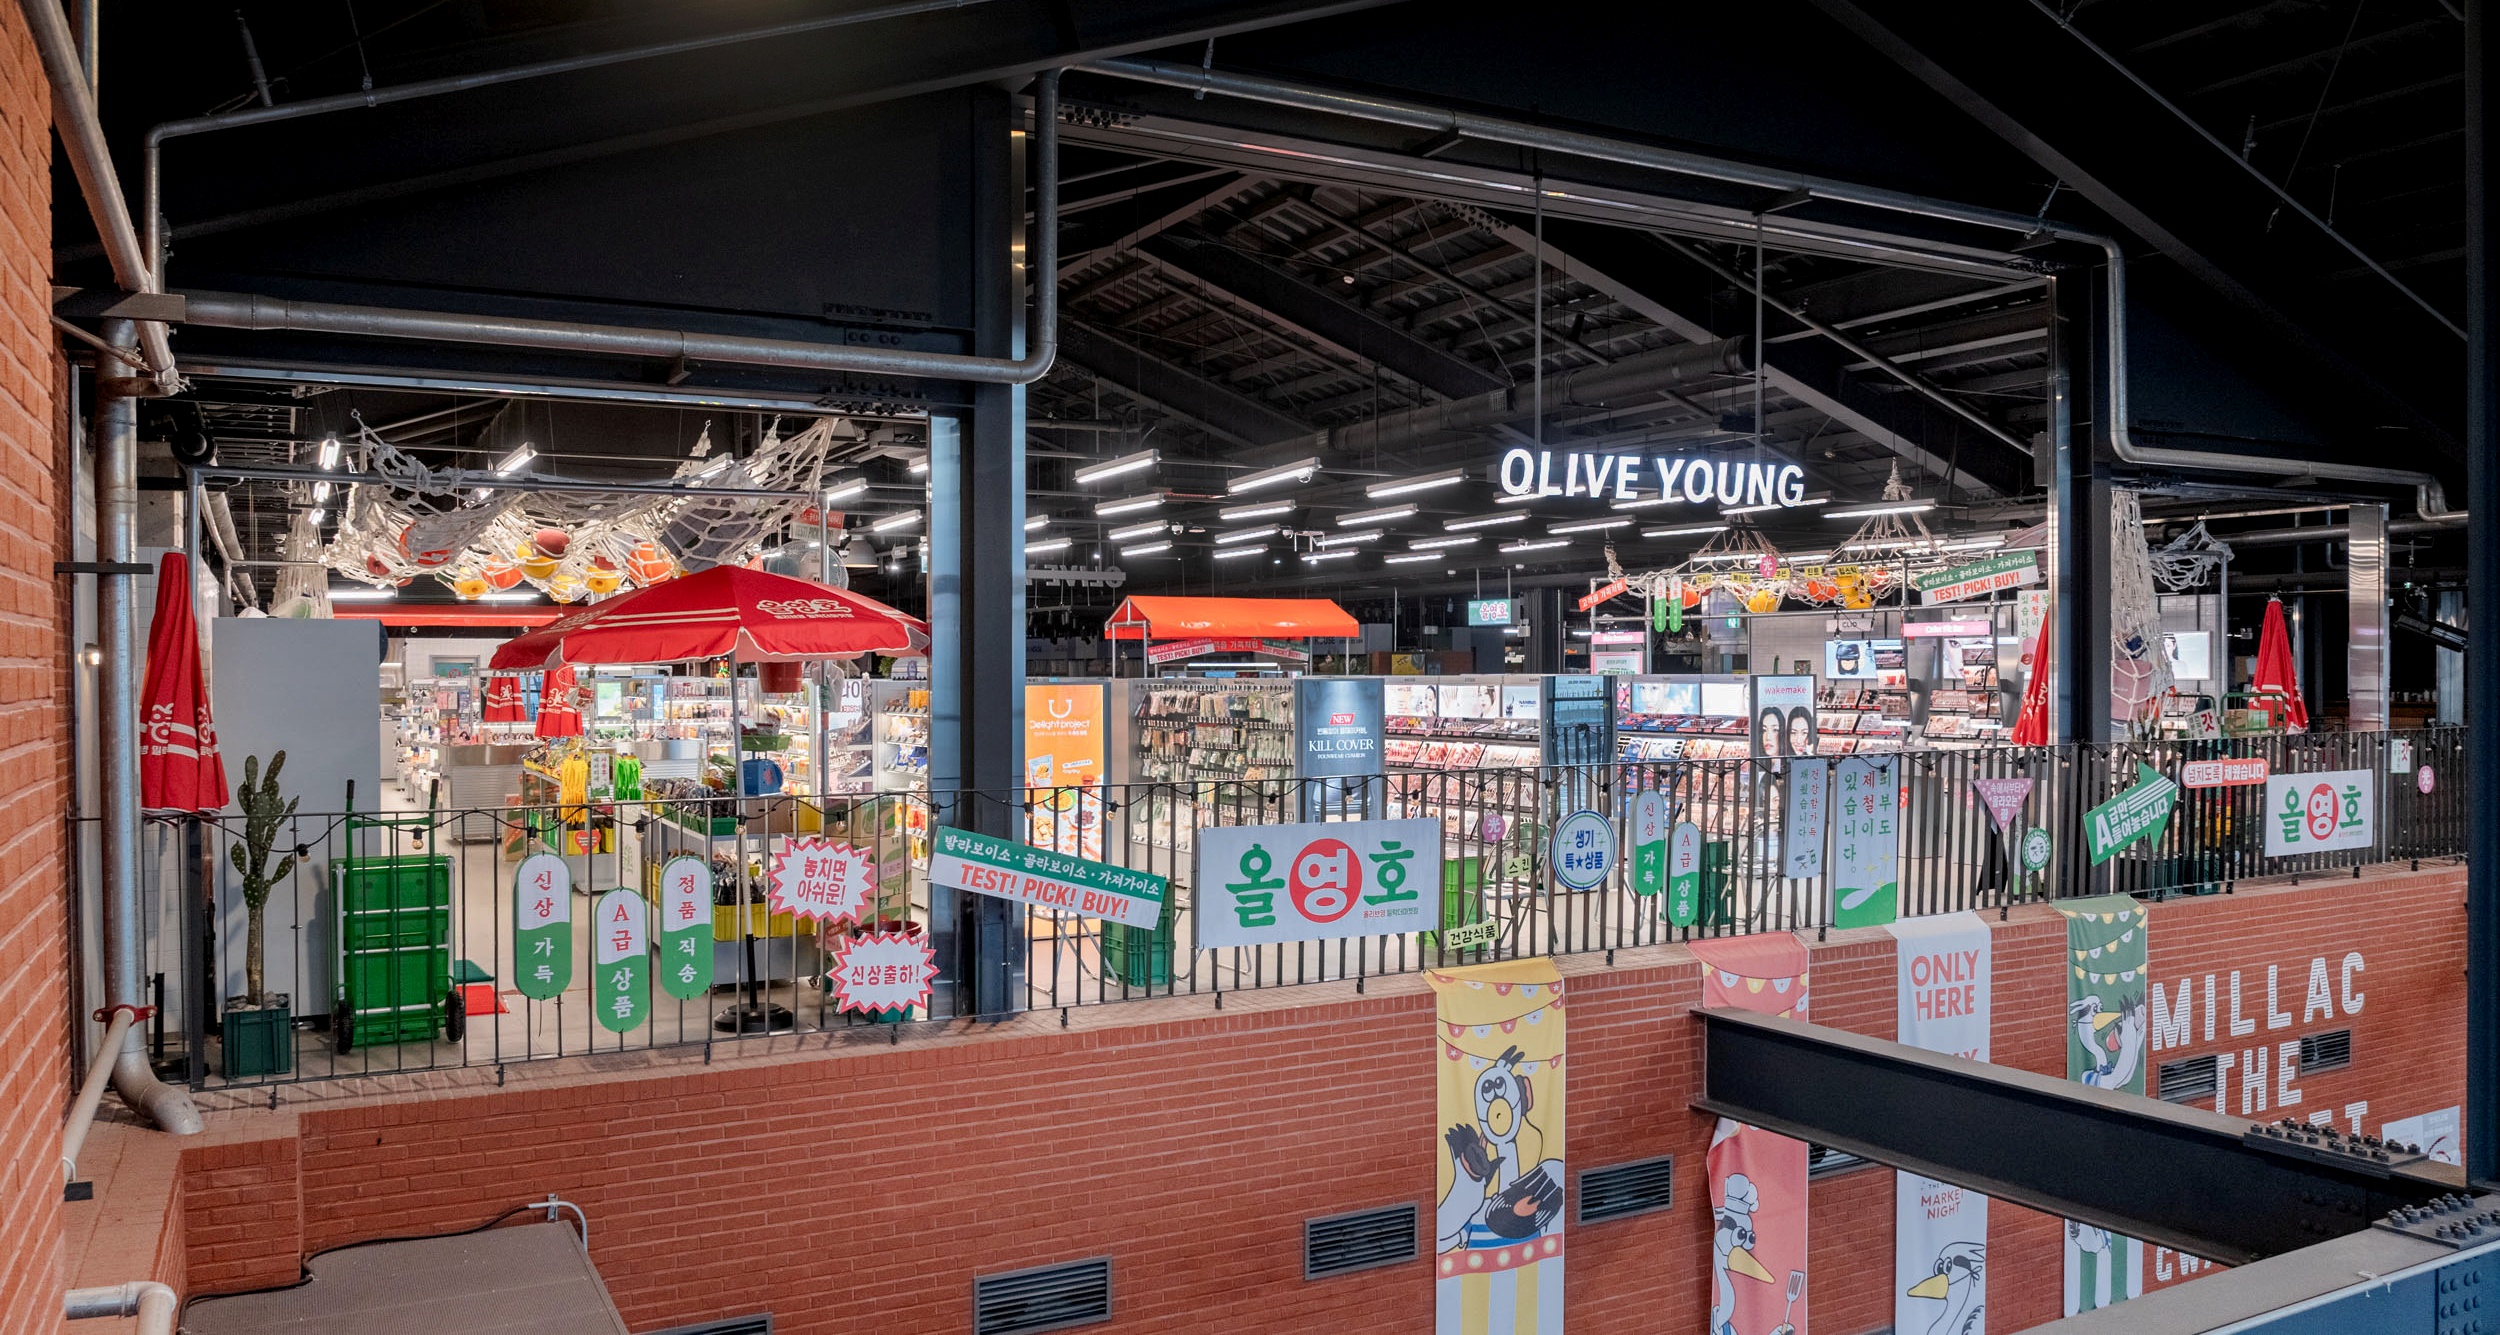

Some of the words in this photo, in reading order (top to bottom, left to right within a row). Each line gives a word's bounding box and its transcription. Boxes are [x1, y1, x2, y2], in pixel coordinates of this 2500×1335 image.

[1500, 448, 1641, 500] OLIVE
[1656, 457, 1805, 507] YOUNG
[1933, 585, 1961, 602] TEST!
[1963, 578, 1991, 596] PICK!
[1994, 571, 2020, 588] BUY!
[1157, 652, 1173, 661] TEST!
[1174, 650, 1191, 659] PICK!
[1764, 686, 1807, 695] wakemake
[1333, 715, 1352, 724] NEW
[2200, 711, 2215, 733] 갓
[1309, 740, 1334, 752] KILL
[1336, 738, 1375, 751] COVER
[2188, 763, 2221, 783] 넘치도록
[2223, 762, 2265, 781] 채웠습니다
[1644, 802, 1656, 837] 신상
[1861, 770, 1875, 837] 제철이
[2279, 784, 2363, 843] 올영호
[1487, 818, 1501, 833] 光
[1575, 829, 1594, 849] 생기
[804, 856, 848, 882] 놓치면
[944, 834, 1012, 863] 발라보이소
[1023, 852, 1088, 879] 골라보이소
[1099, 870, 1160, 896] 가져가이소
[1509, 858, 1529, 874] 스킨
[1643, 850, 1655, 885] 가득
[1680, 833, 1692, 869] A급
[534, 870, 554, 918] 신상
[678, 874, 697, 920] 정품
[797, 880, 847, 906] 아쉬운!
[960, 863, 1018, 895] TEST!
[1021, 877, 1077, 907] PICK!
[1081, 890, 1130, 919] BUY!
[1225, 840, 1419, 928] 올영호
[1676, 880, 1691, 918] 상품
[611, 903, 633, 952] A급
[1450, 924, 1496, 946] 건강식품
[533, 937, 555, 984] 가득
[678, 937, 698, 984] 직송
[1911, 948, 1980, 987] ONLY
[610, 967, 635, 1020] 상품
[1915, 984, 1976, 1022] HERE
[2152, 952, 2365, 1051] MILLAC
[2215, 1040, 2302, 1115] THE
[1927, 1201, 1961, 1220] NIGHT
